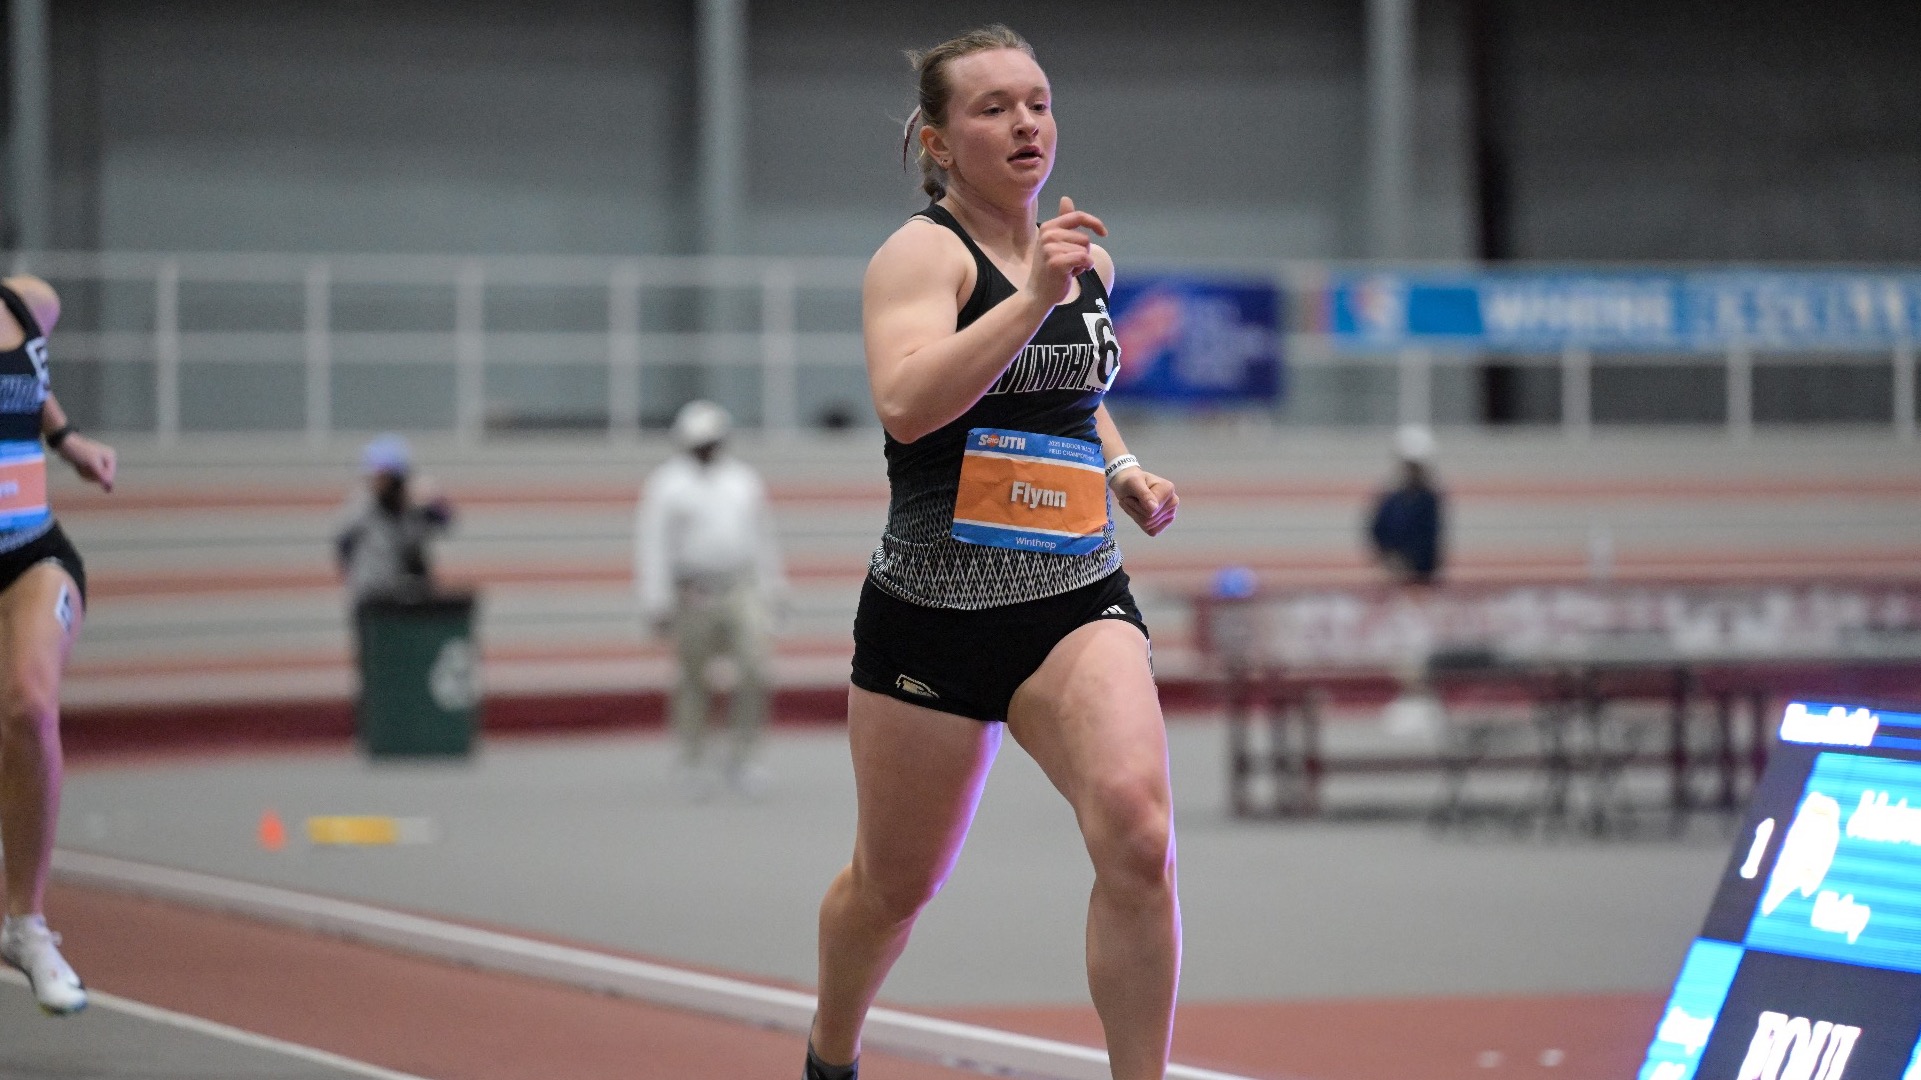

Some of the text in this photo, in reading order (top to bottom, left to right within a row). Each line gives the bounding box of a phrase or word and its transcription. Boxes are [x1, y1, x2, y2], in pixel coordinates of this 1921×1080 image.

[1095, 317, 1118, 384] 6
[1010, 481, 1067, 509] Flynn
[1015, 536, 1057, 549] Winthrop
